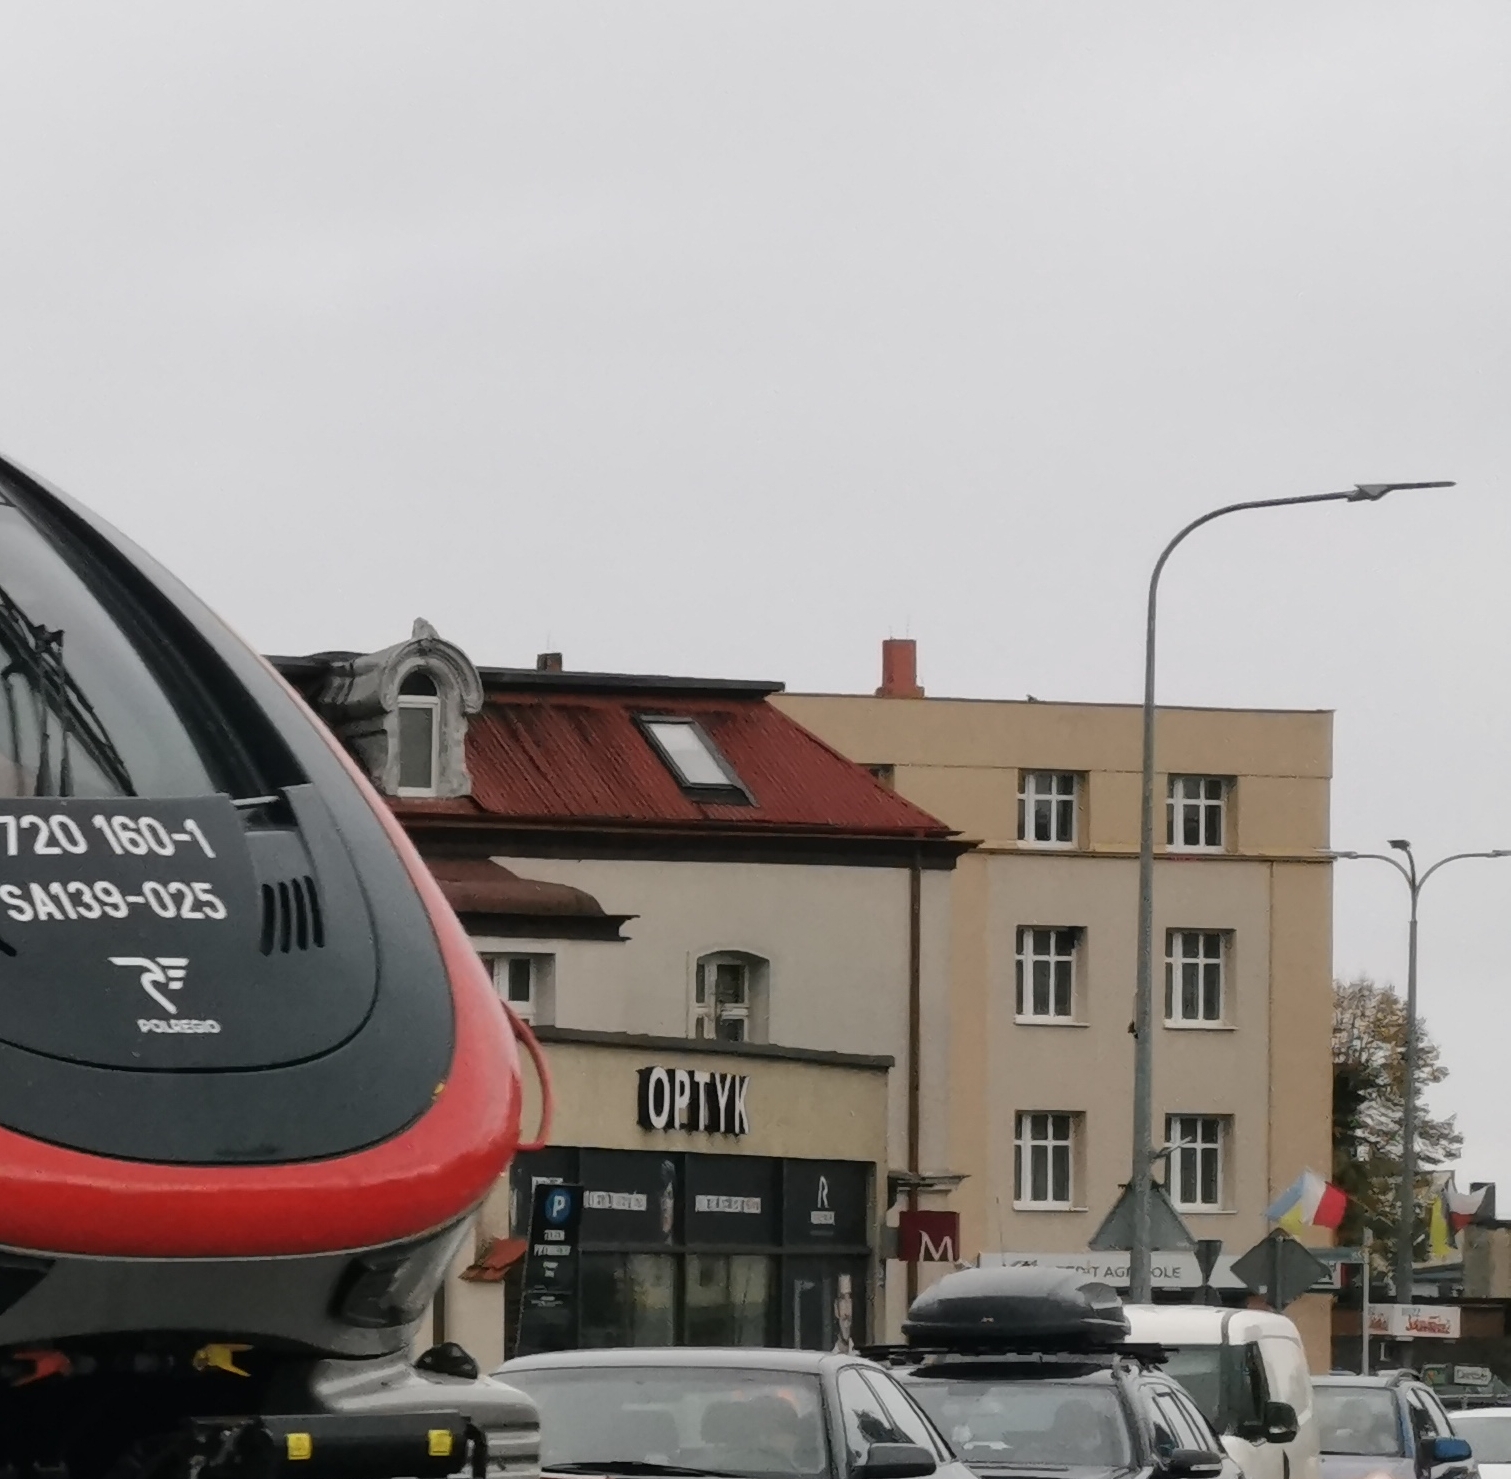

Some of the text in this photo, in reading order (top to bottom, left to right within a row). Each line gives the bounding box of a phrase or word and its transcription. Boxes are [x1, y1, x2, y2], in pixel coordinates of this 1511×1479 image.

[92, 814, 217, 858] 160-1
[646, 1065, 751, 1135] OPTYK
[552, 1195, 566, 1217] P
